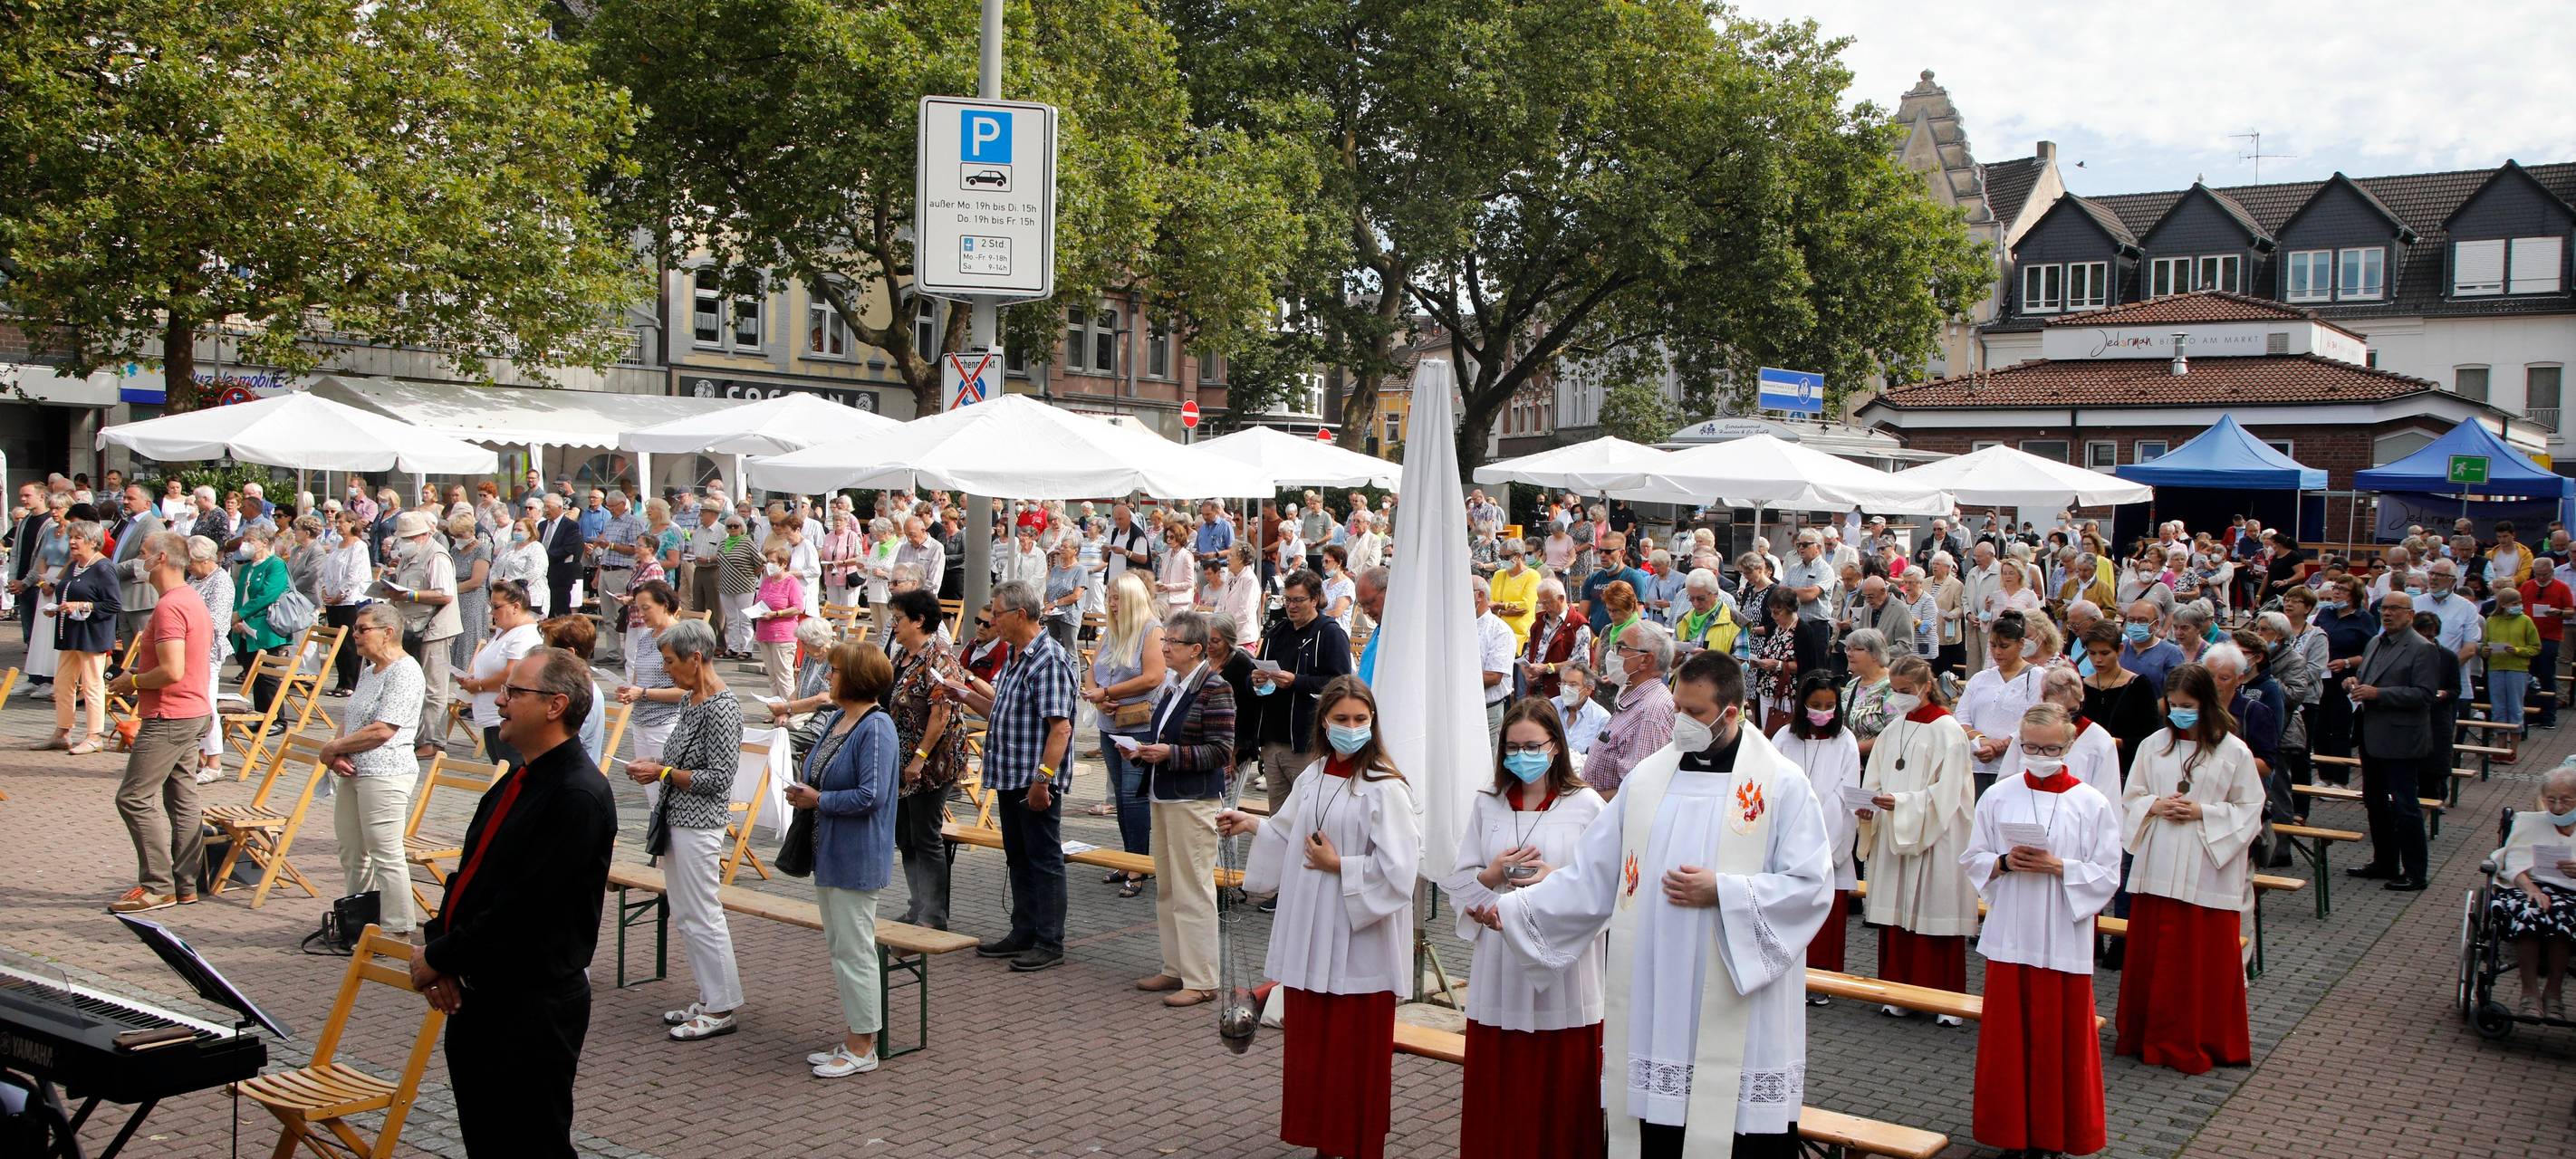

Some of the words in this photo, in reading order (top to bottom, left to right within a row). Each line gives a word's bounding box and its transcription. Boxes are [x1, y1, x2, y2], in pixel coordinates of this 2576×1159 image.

[973, 117, 1000, 156] P
[929, 200, 955, 208] außer
[957, 201, 972, 209] Mo.
[976, 202, 990, 210] 19h
[994, 203, 1005, 211] bis
[1008, 204, 1019, 212] Di.
[1023, 205, 1037, 213] 15h
[957, 215, 971, 223] Do.
[975, 216, 989, 224] 19h
[992, 216, 1004, 225] bis
[1007, 217, 1017, 225] Fr.
[1021, 218, 1034, 226] 15h
[981, 239, 986, 248] 2
[989, 239, 1006, 249] Std.
[2159, 337, 2196, 345] BISO
[2224, 335, 2260, 343] MARKT
[950, 359, 995, 369] Wchenmrkt
[726, 386, 844, 405] COCN
[13, 1036, 53, 1068] YAMAHA
